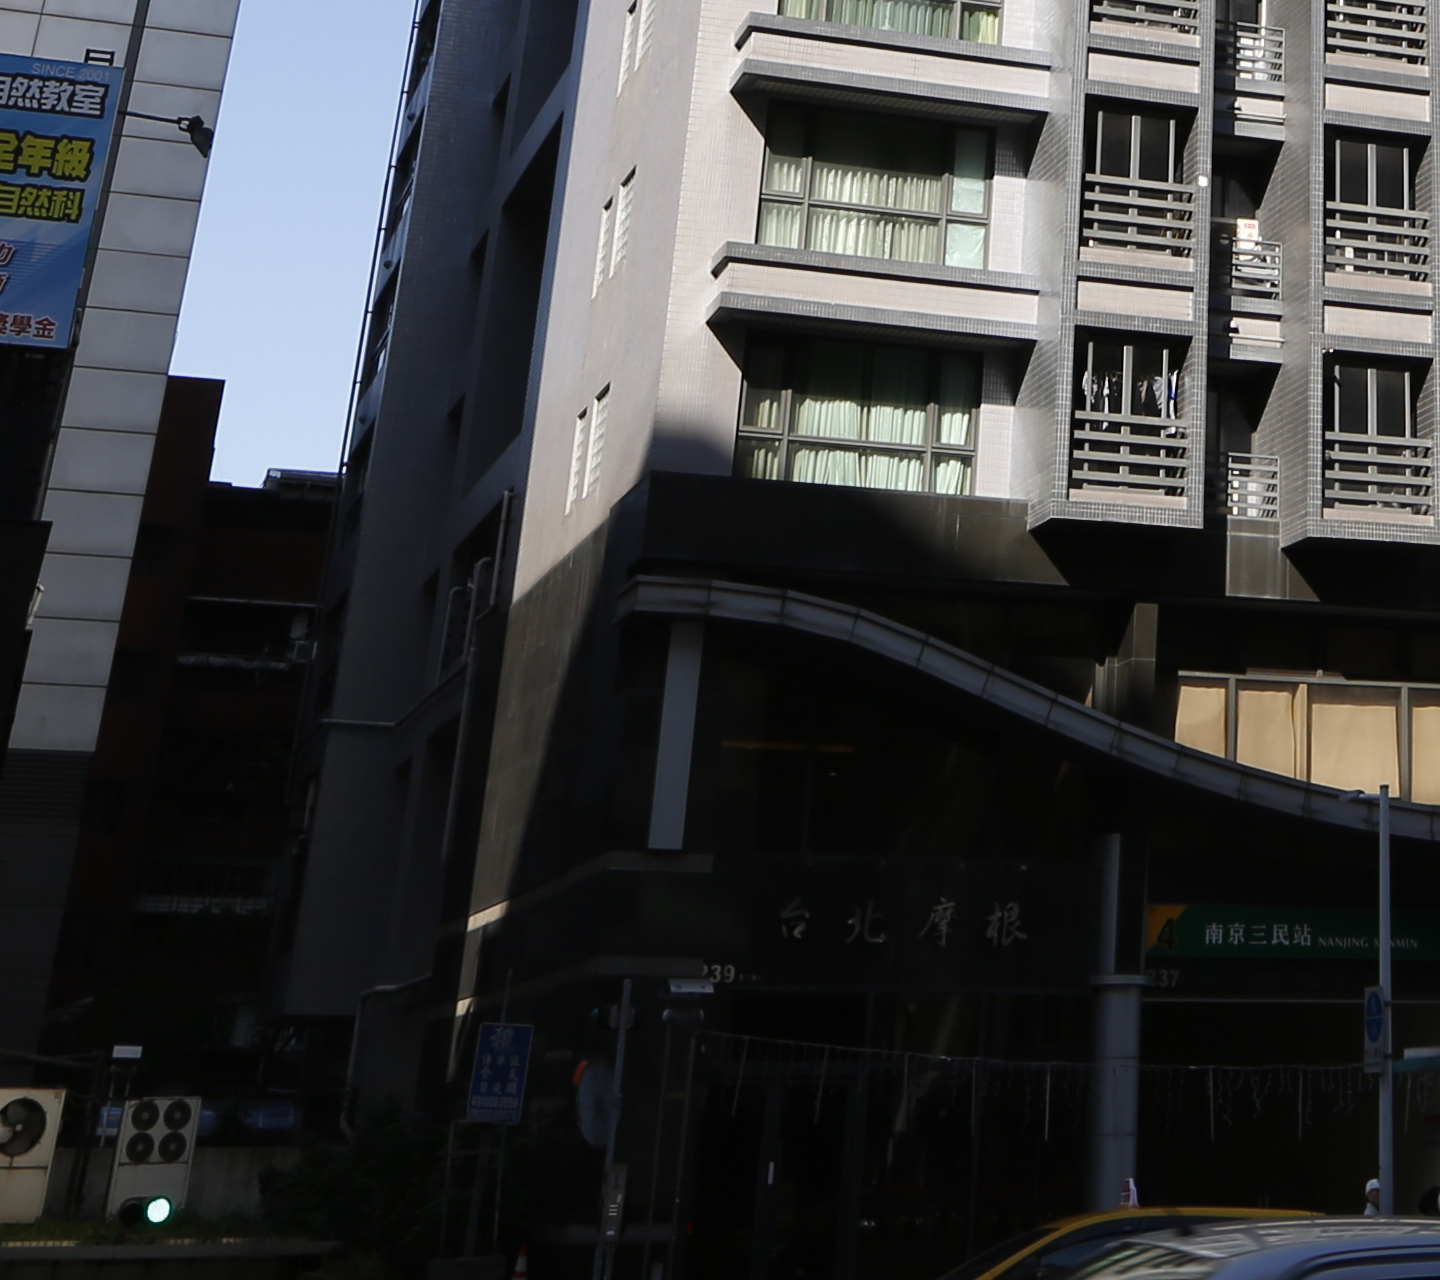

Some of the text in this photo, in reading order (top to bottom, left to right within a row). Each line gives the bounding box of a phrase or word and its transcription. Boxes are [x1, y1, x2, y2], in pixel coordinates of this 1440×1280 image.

[31, 62, 113, 83] SINCE 2001
[778, 896, 1029, 947] 台北摩根
[1205, 921, 1312, 947] 南京三民站
[1318, 936, 1419, 950] NANJING SNMIN
